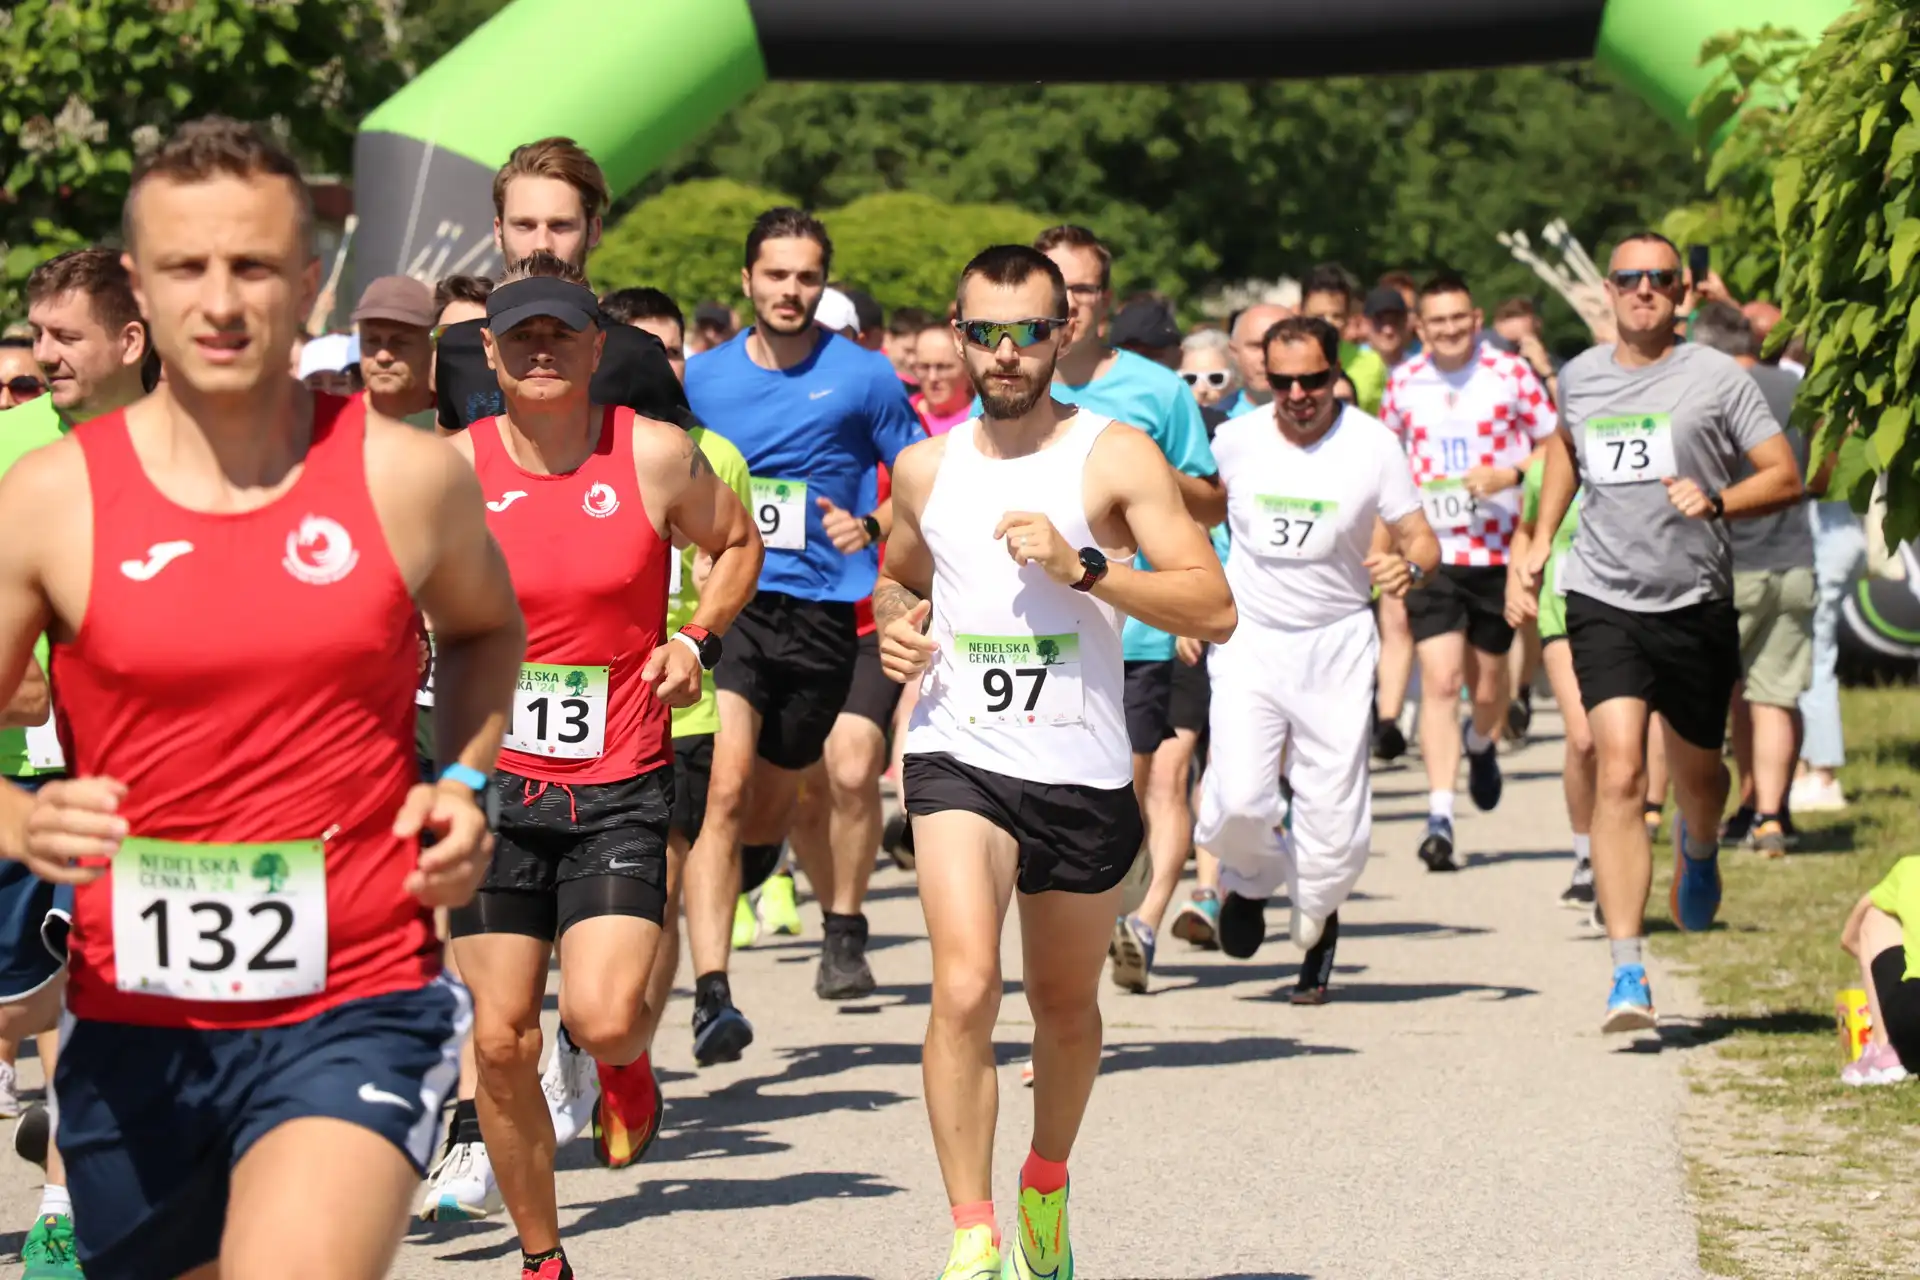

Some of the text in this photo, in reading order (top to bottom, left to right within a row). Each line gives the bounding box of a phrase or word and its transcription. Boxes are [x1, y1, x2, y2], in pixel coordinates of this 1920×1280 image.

[1606, 439, 1650, 471] 73
[759, 504, 780, 535] 9
[1269, 517, 1314, 548] 37
[968, 642, 1030, 654] NEDELSKA
[969, 653, 1006, 664] CENKA
[983, 667, 1048, 712] 97
[507, 697, 590, 743] 13
[140, 898, 297, 972] 132
